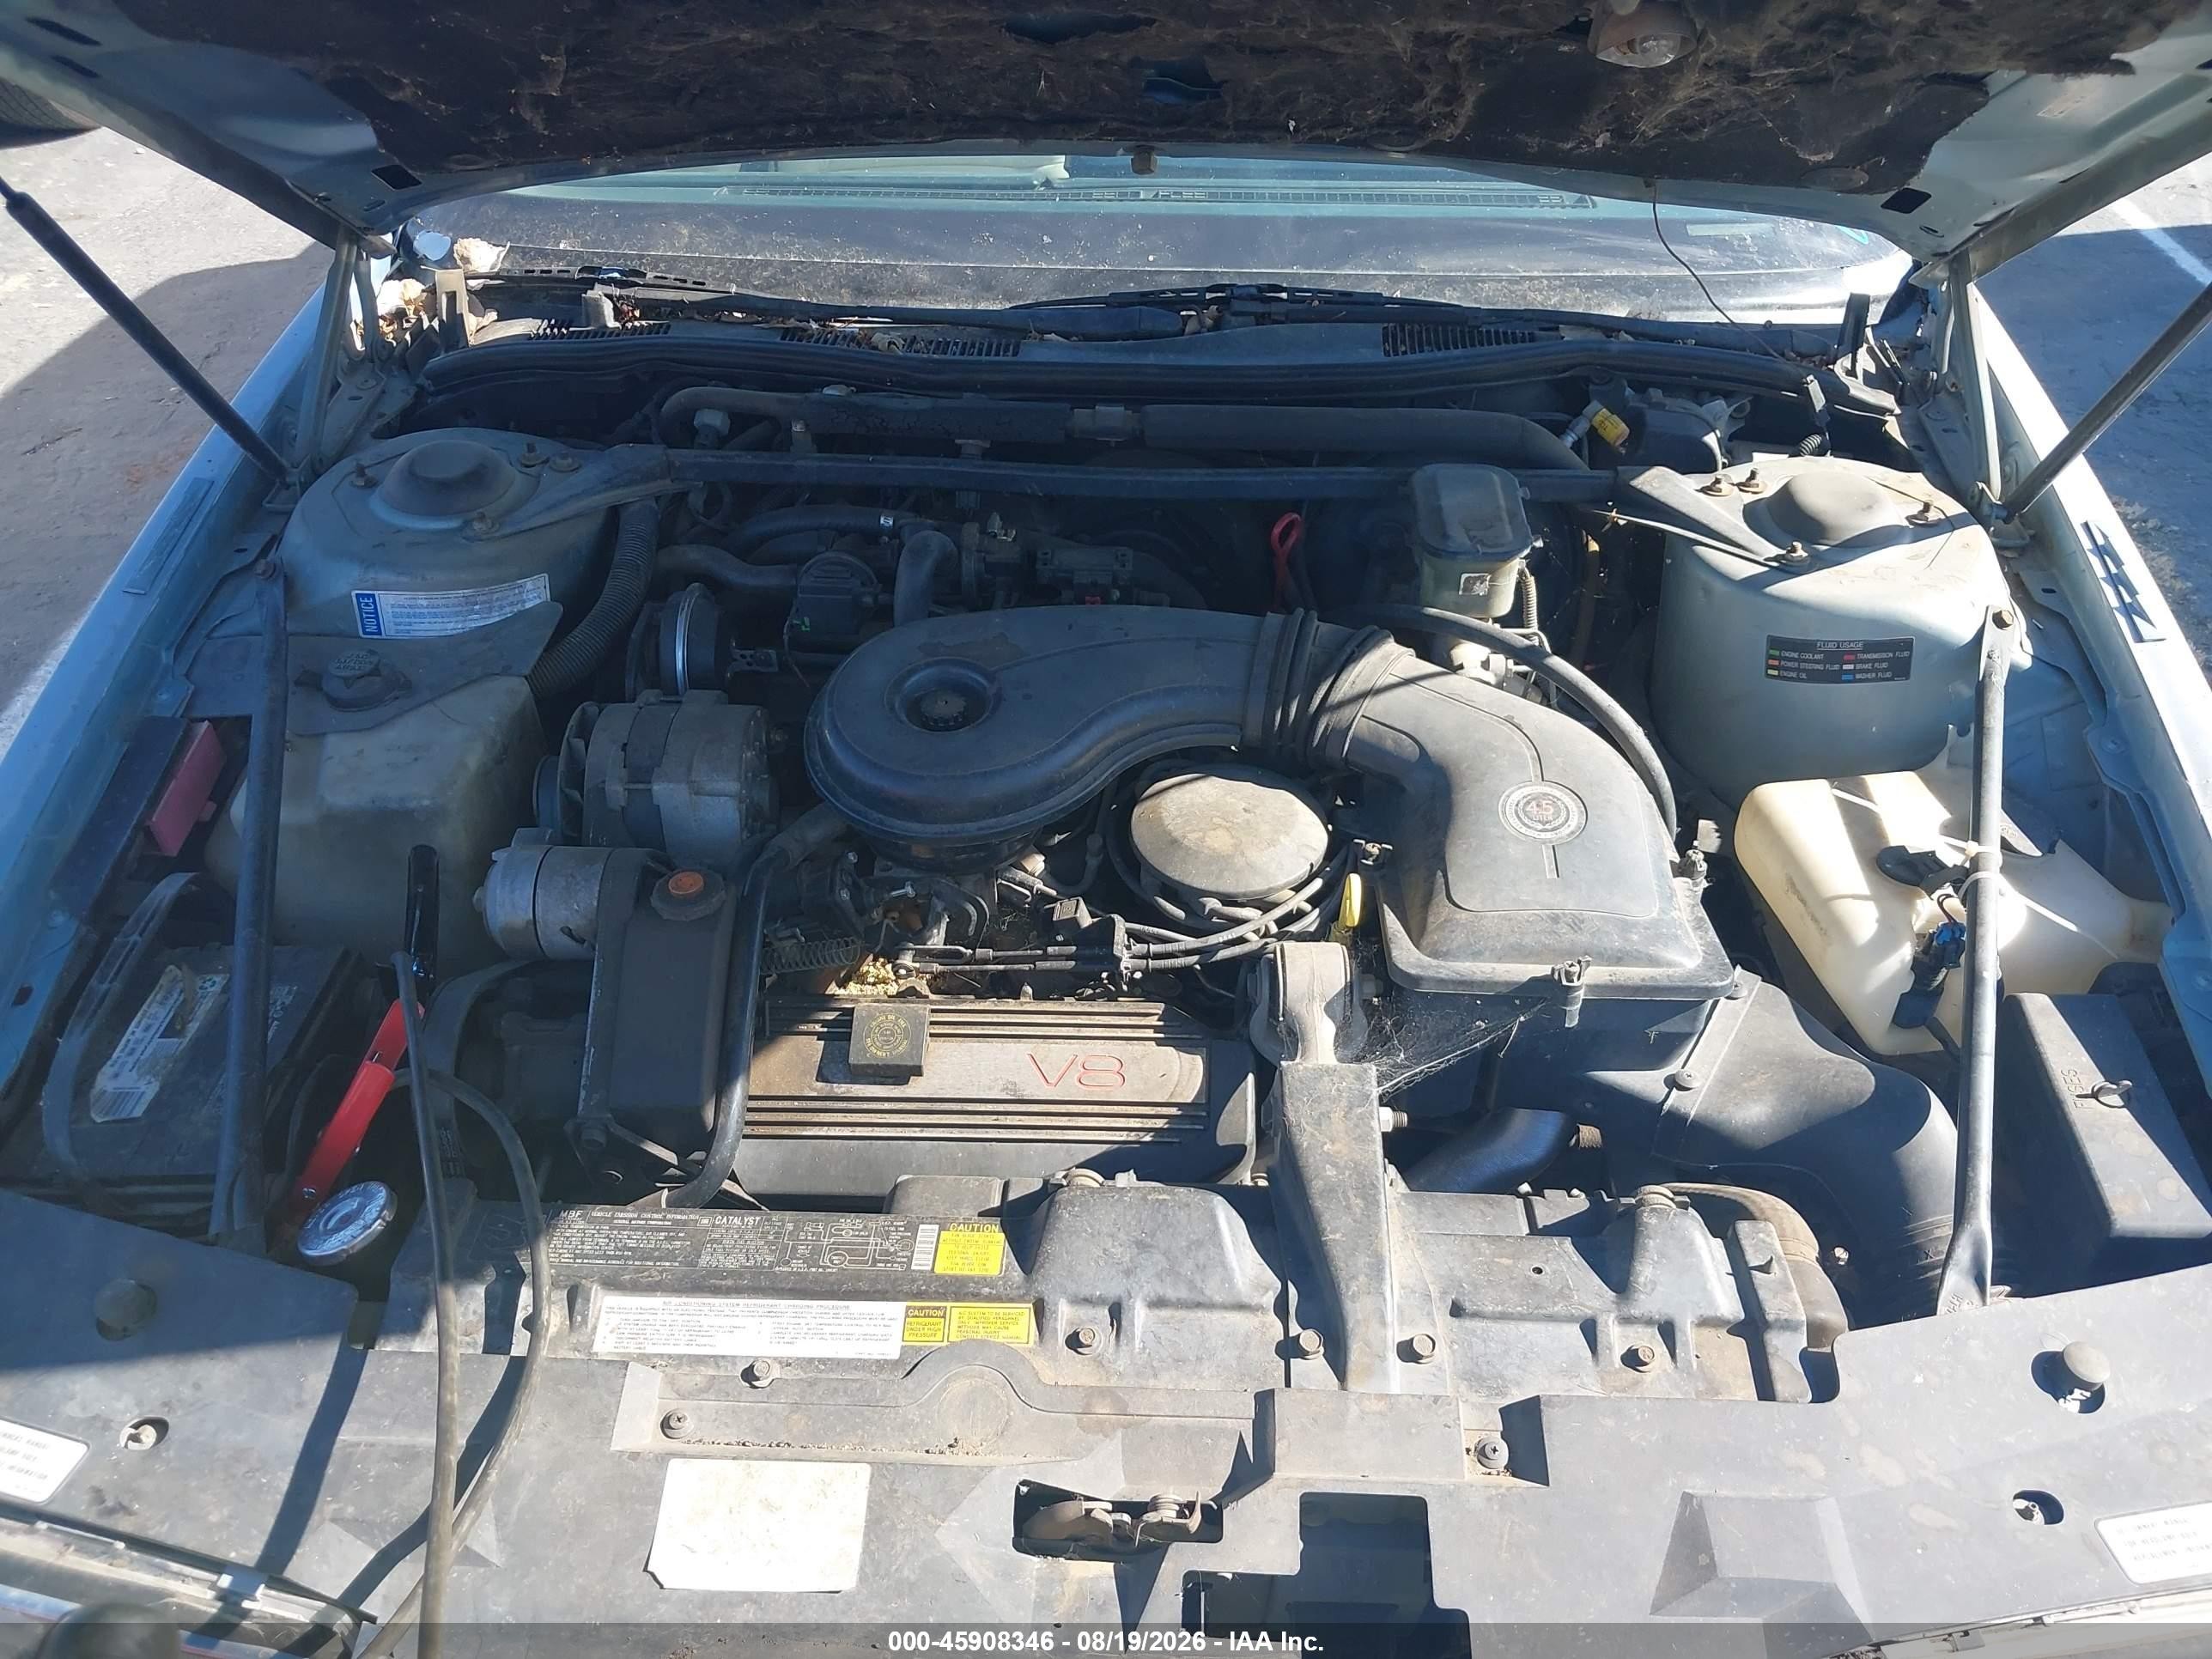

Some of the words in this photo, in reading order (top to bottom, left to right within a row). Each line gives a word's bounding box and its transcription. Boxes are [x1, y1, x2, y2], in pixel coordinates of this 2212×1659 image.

[359, 598, 378, 632] NOTICE
[1026, 1053, 1127, 1091] V8
[714, 1216, 761, 1224] CATALYST
[950, 1223, 1000, 1233] CAUTION
[908, 1309, 944, 1317] CAUTION
